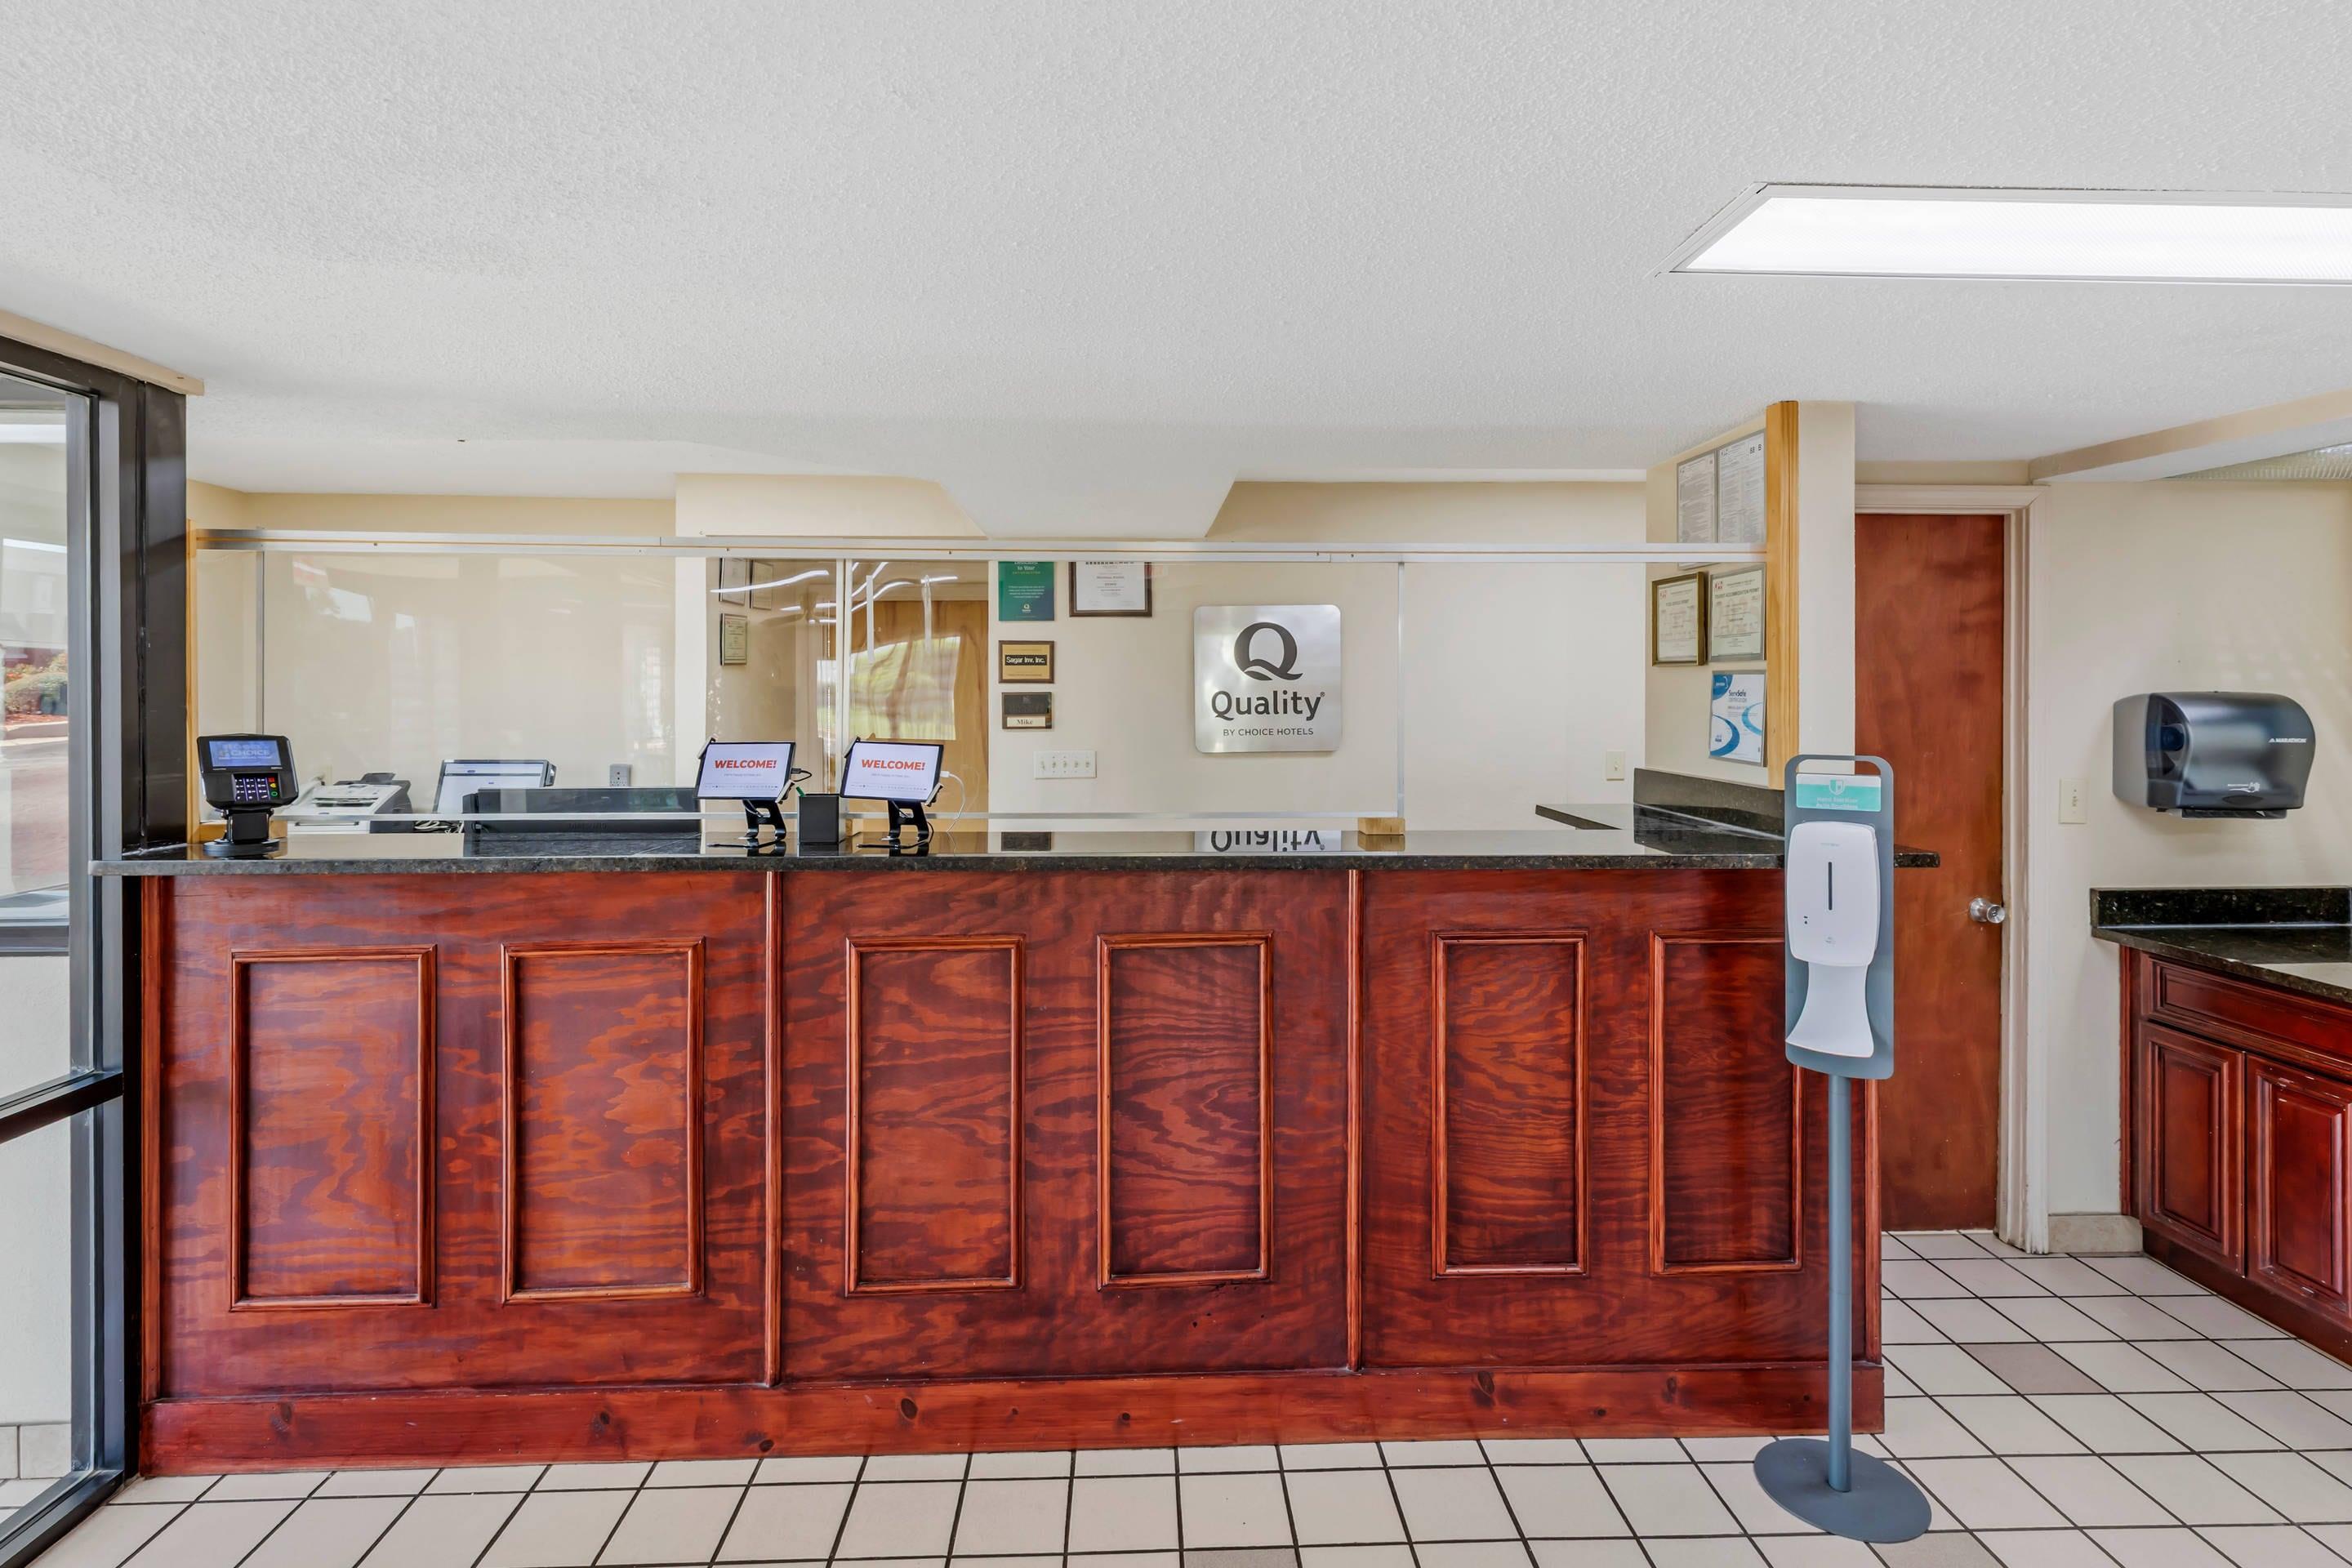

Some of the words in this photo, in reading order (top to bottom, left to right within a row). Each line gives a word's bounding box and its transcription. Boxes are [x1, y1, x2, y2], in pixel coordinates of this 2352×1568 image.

[1234, 621, 1303, 681] Q
[1006, 656, 1023, 665] Sagar
[1024, 656, 1035, 664] Inv.
[1035, 656, 1045, 664] Inc.
[1211, 689, 1321, 721] Quality
[715, 760, 777, 768] WELCOME!
[862, 760, 926, 770] WELCOME!
